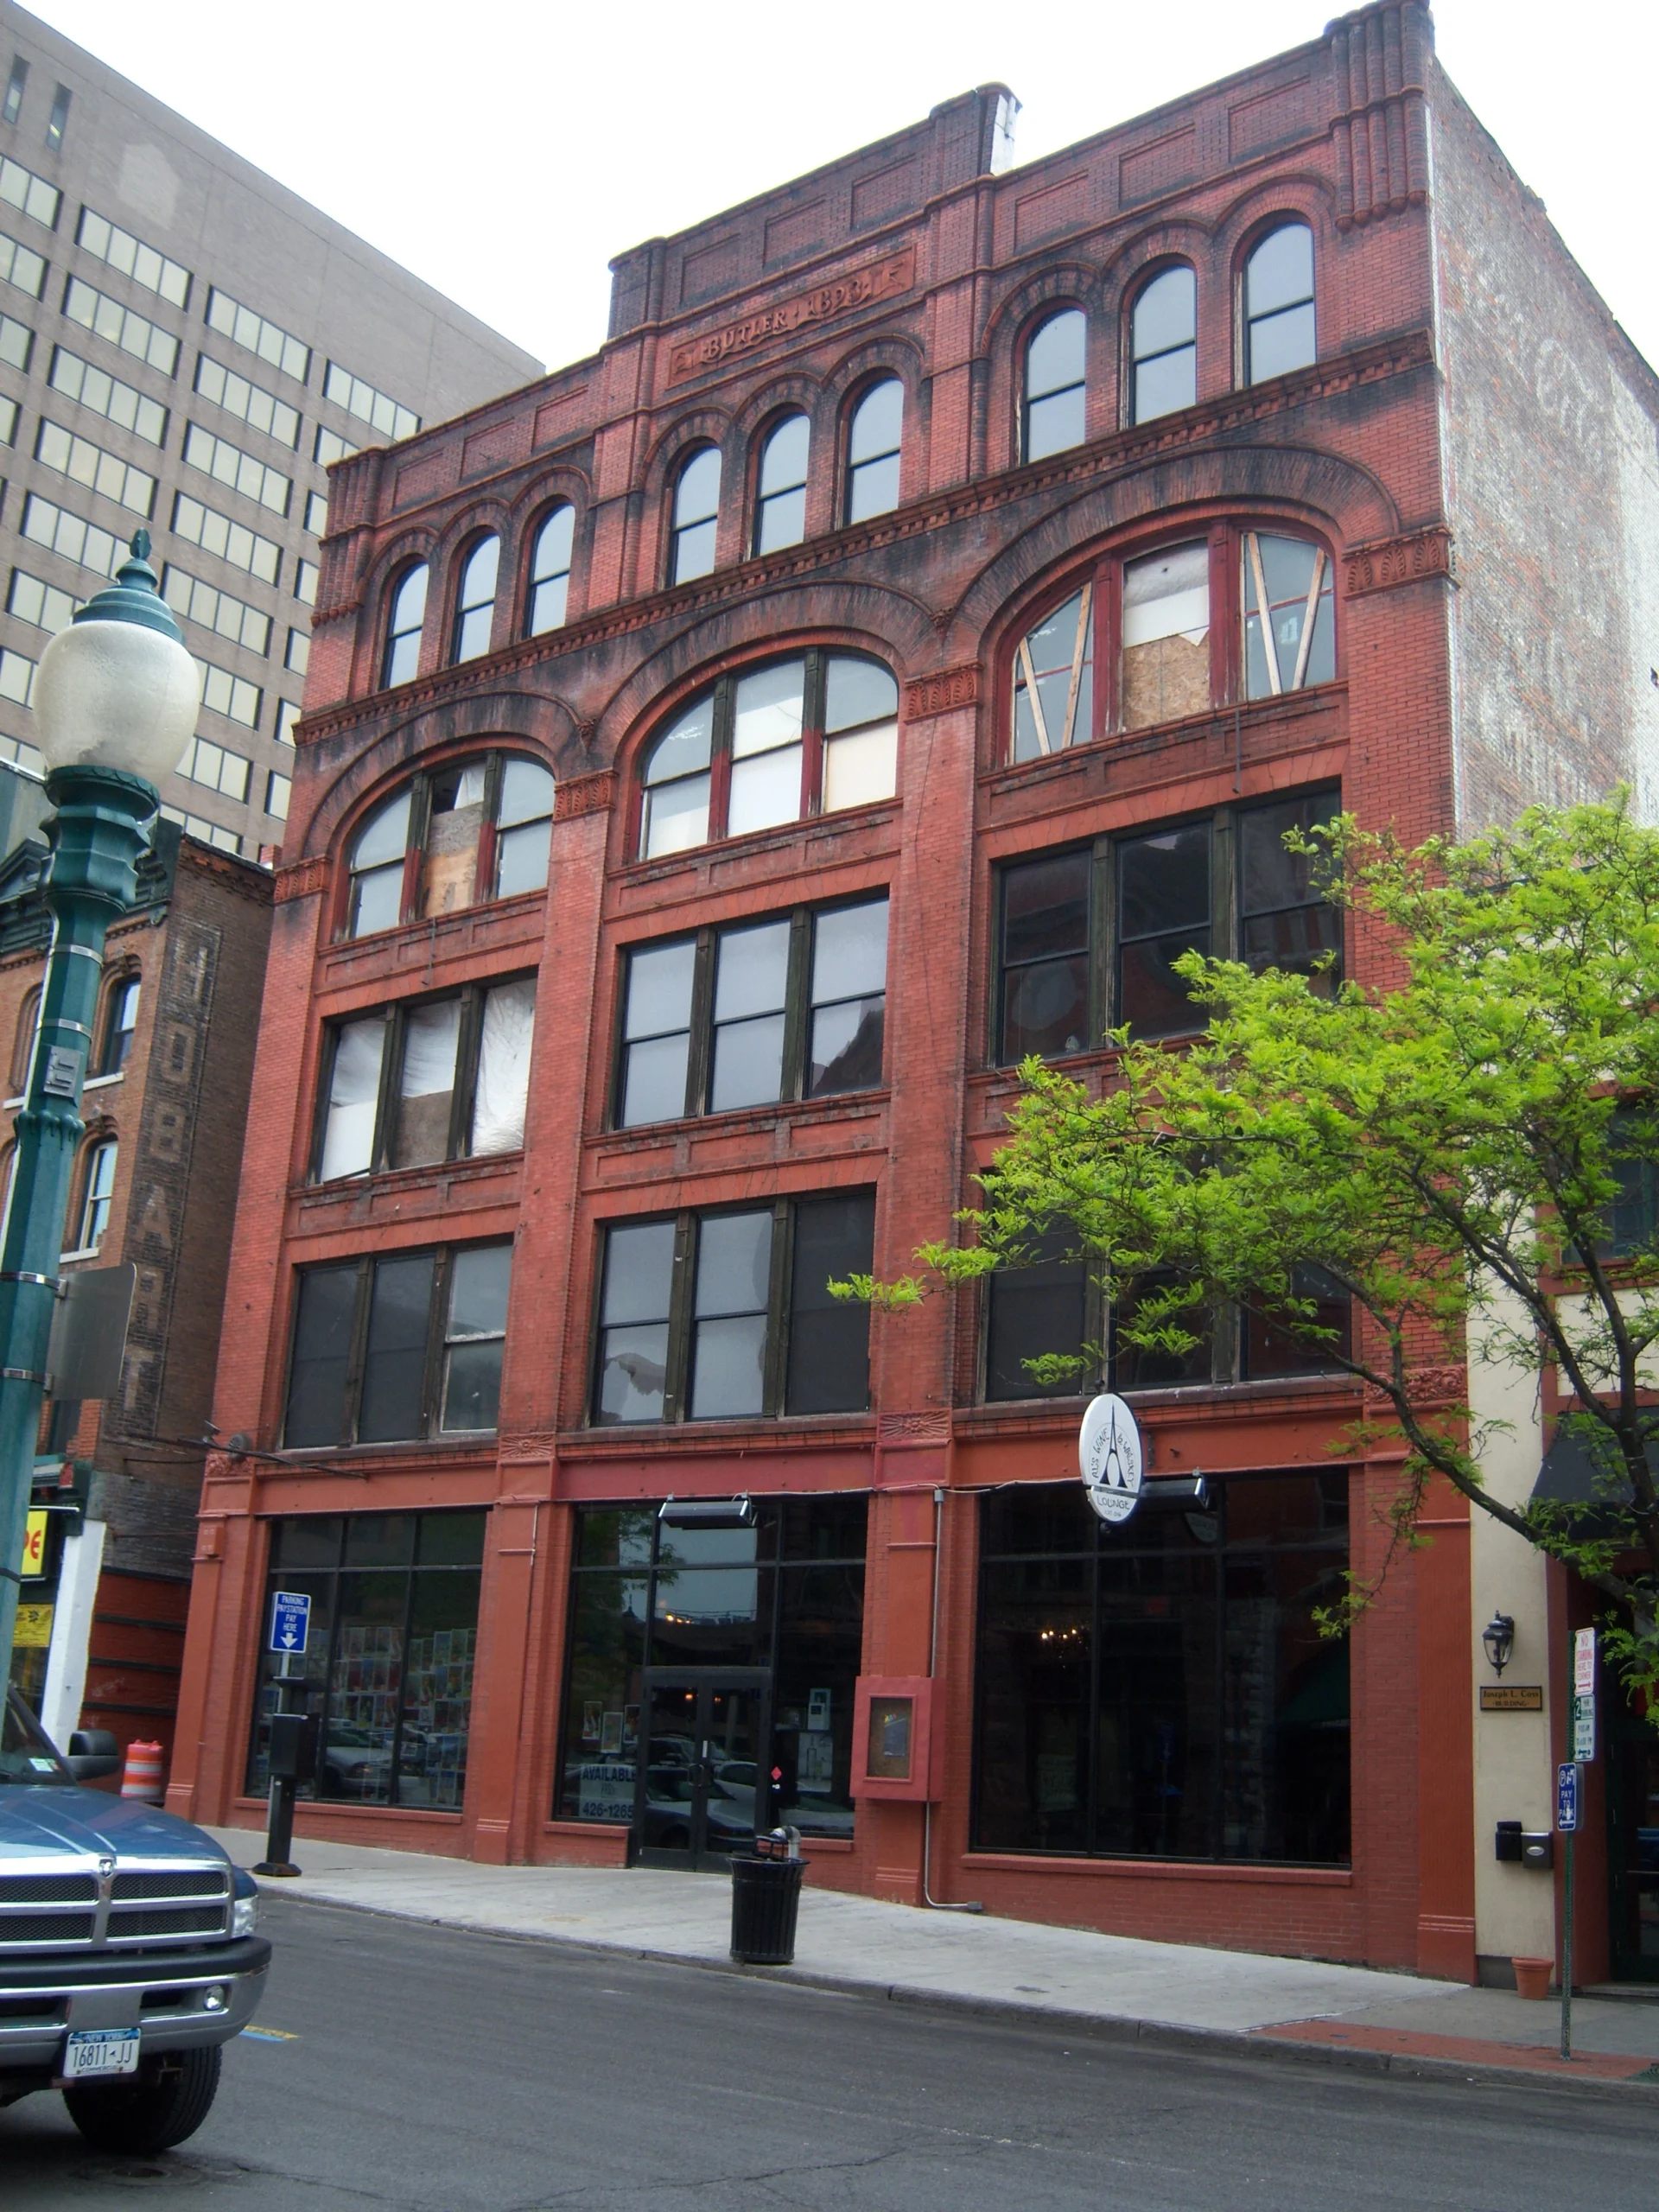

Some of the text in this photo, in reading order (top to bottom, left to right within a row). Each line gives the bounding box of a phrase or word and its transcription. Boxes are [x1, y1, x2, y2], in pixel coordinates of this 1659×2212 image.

[708, 278, 863, 361] BUTLER 1893
[1093, 1427, 1109, 1453] WINE
[1096, 1495, 1130, 1510] LOUNGE
[282, 1595, 305, 1606] PARKING
[285, 1613, 297, 1623] PAY
[283, 1622, 298, 1632] HERE
[1580, 1635, 1588, 1647] NO
[1577, 1662, 1586, 1672] HERE
[1578, 1671, 1591, 1681] CORNER
[1483, 1689, 1508, 1699] Joseph
[1576, 1700, 1581, 1717] 2
[583, 1765, 636, 1782] AVAILABLE
[1561, 1789, 1572, 1799] PAY
[1563, 1800, 1571, 1808] TO
[583, 1802, 633, 1819] 426-1265
[83, 2034, 102, 2043] NEW
[73, 2044, 108, 2068] 16811
